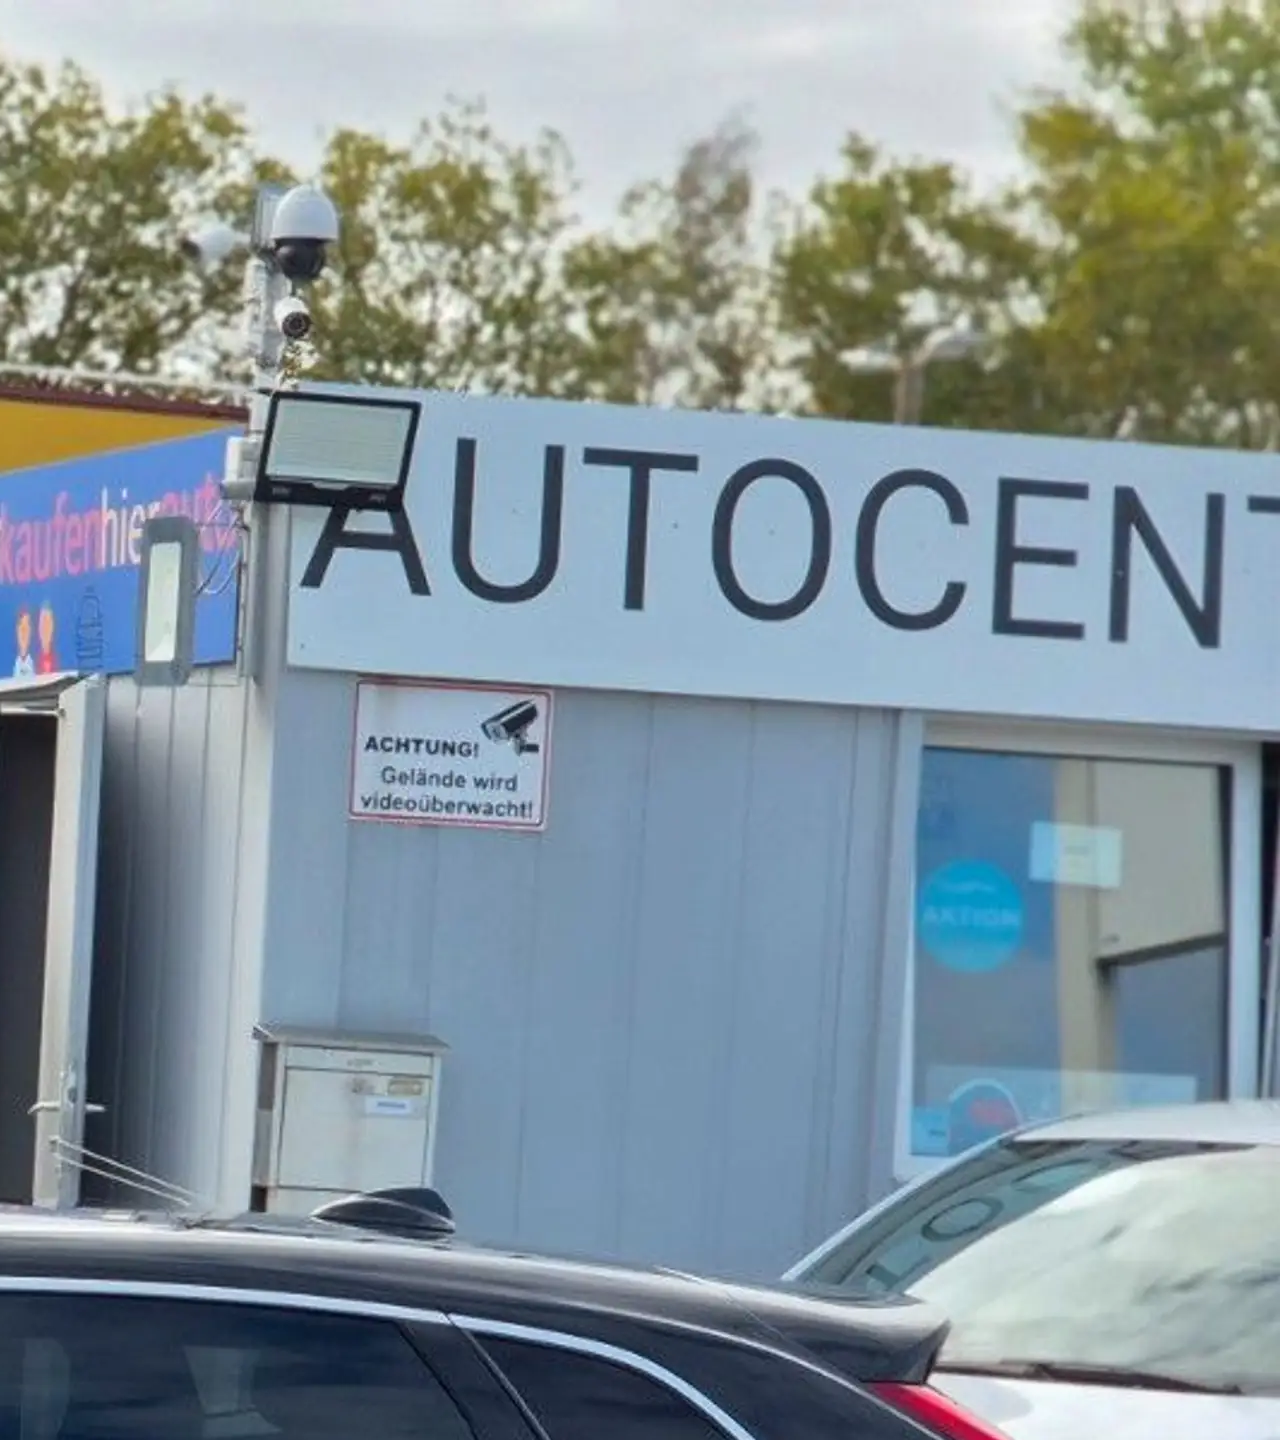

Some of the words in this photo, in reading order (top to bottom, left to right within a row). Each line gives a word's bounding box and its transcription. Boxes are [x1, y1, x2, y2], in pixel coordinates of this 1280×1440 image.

[299, 437, 1280, 648] AUTOCEN
[364, 736, 479, 758] ACHTUNG!
[381, 766, 466, 789] Gelände
[473, 773, 518, 792] wird
[360, 792, 533, 818] videoüberwacht!
